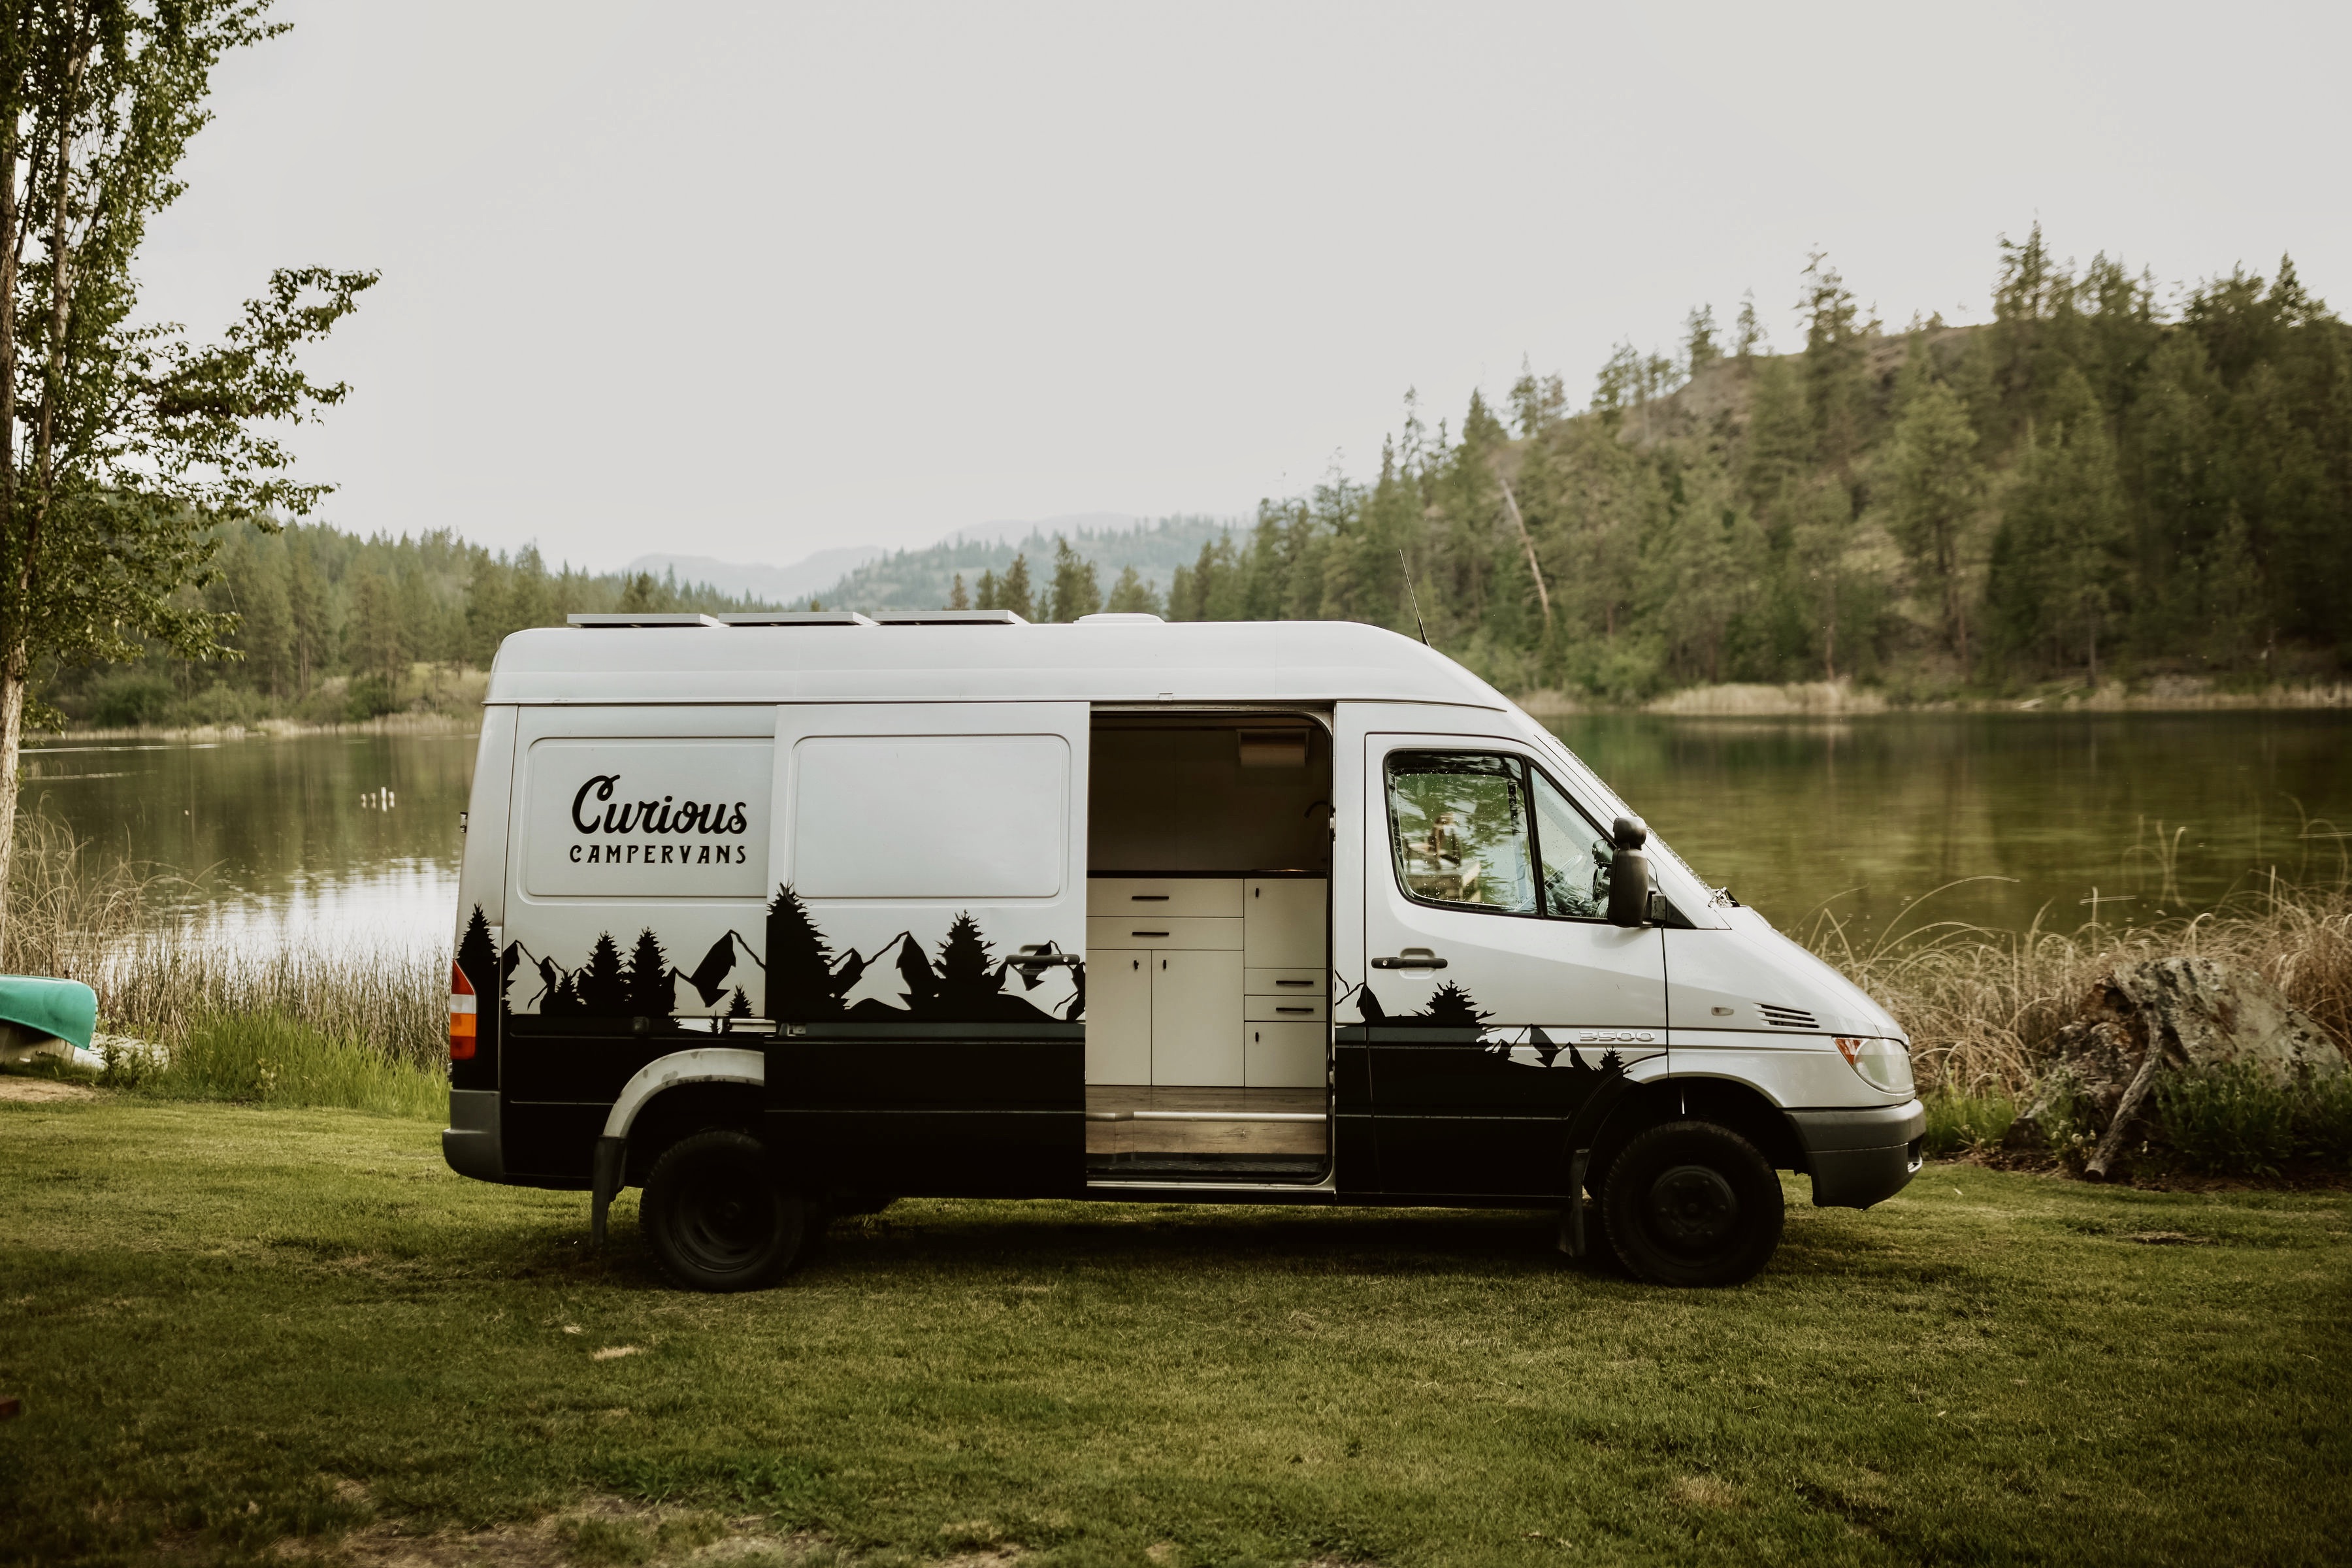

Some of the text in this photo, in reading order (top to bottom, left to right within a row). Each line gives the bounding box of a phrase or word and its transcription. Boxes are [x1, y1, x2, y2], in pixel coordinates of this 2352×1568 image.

[572, 774, 747, 834] Curious
[569, 844, 746, 864] CAMPERVANS
[1580, 1031, 1655, 1042] 3500
